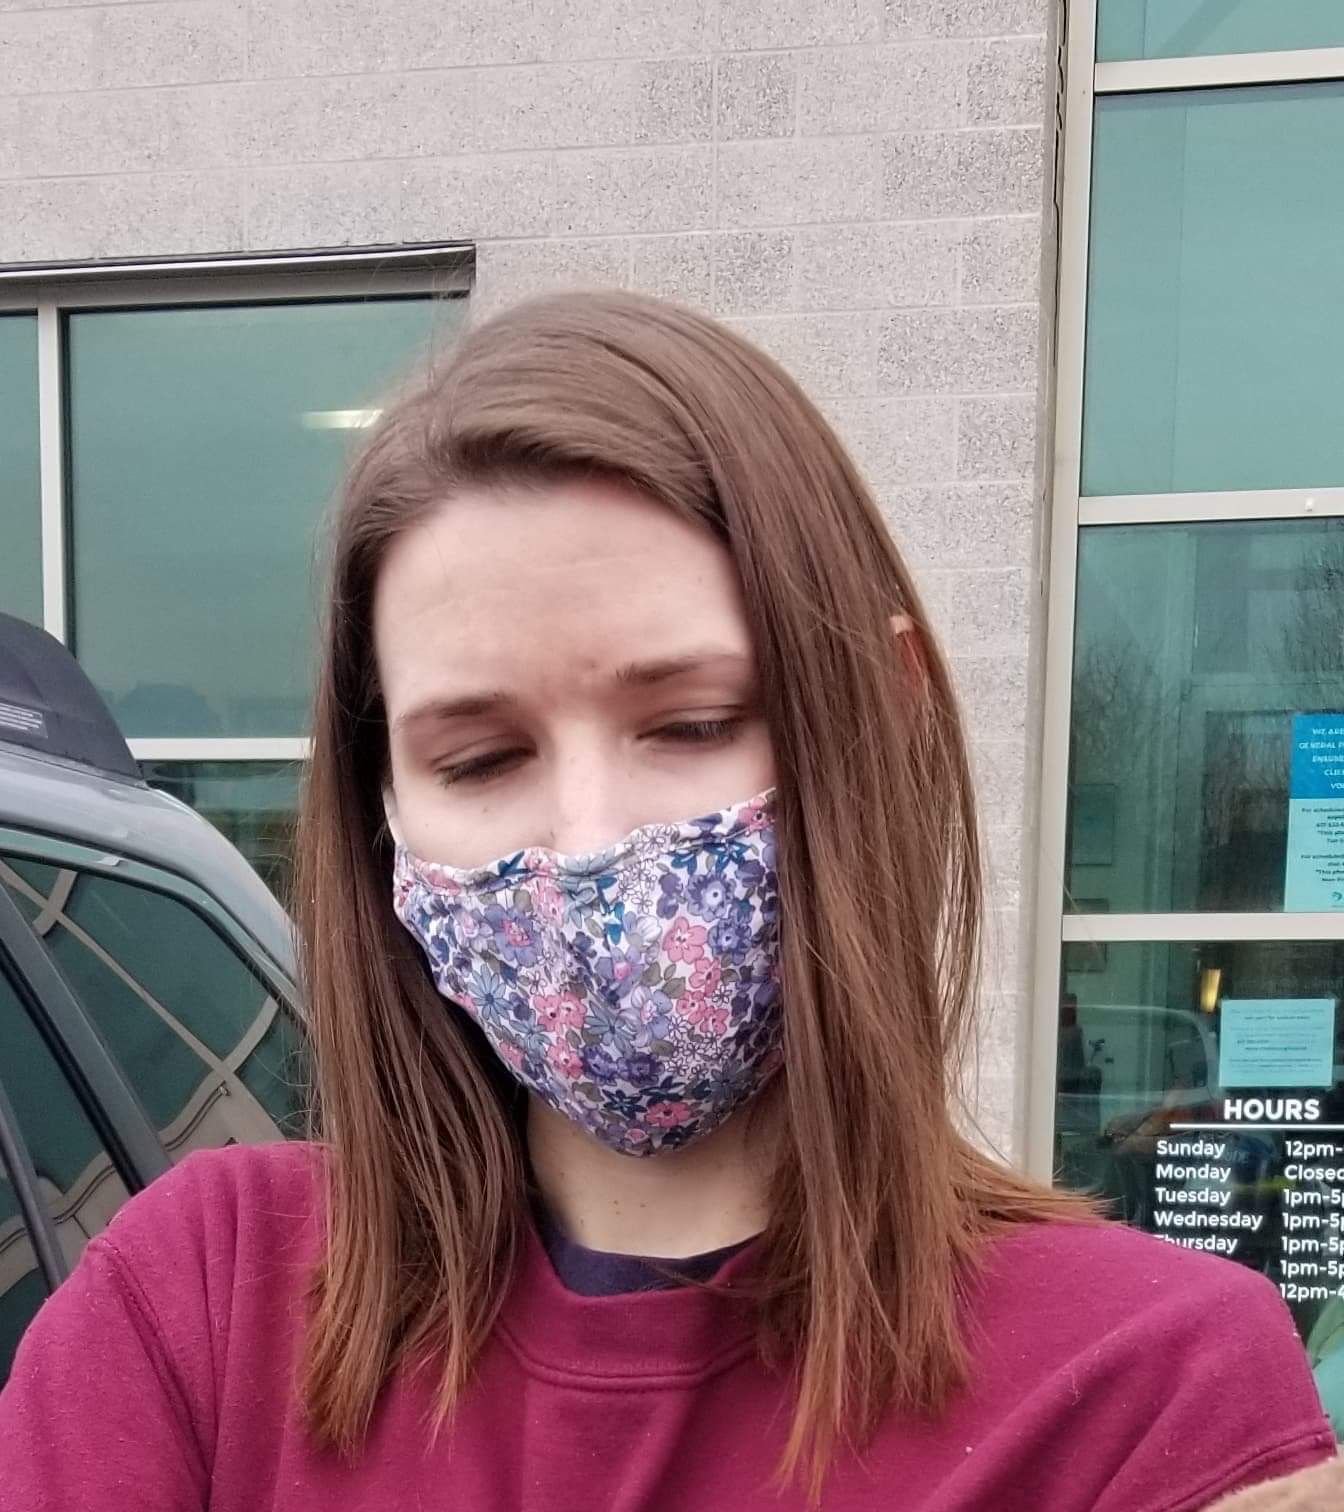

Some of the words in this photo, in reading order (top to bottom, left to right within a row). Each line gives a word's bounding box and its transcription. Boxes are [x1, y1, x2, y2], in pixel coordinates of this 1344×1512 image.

[1222, 1099, 1320, 1120] HOURS
[1156, 1140, 1226, 1159] Sunday
[1156, 1164, 1232, 1183] Monday
[1154, 1188, 1231, 1206] Tuesday
[1154, 1210, 1263, 1230] Wednesday
